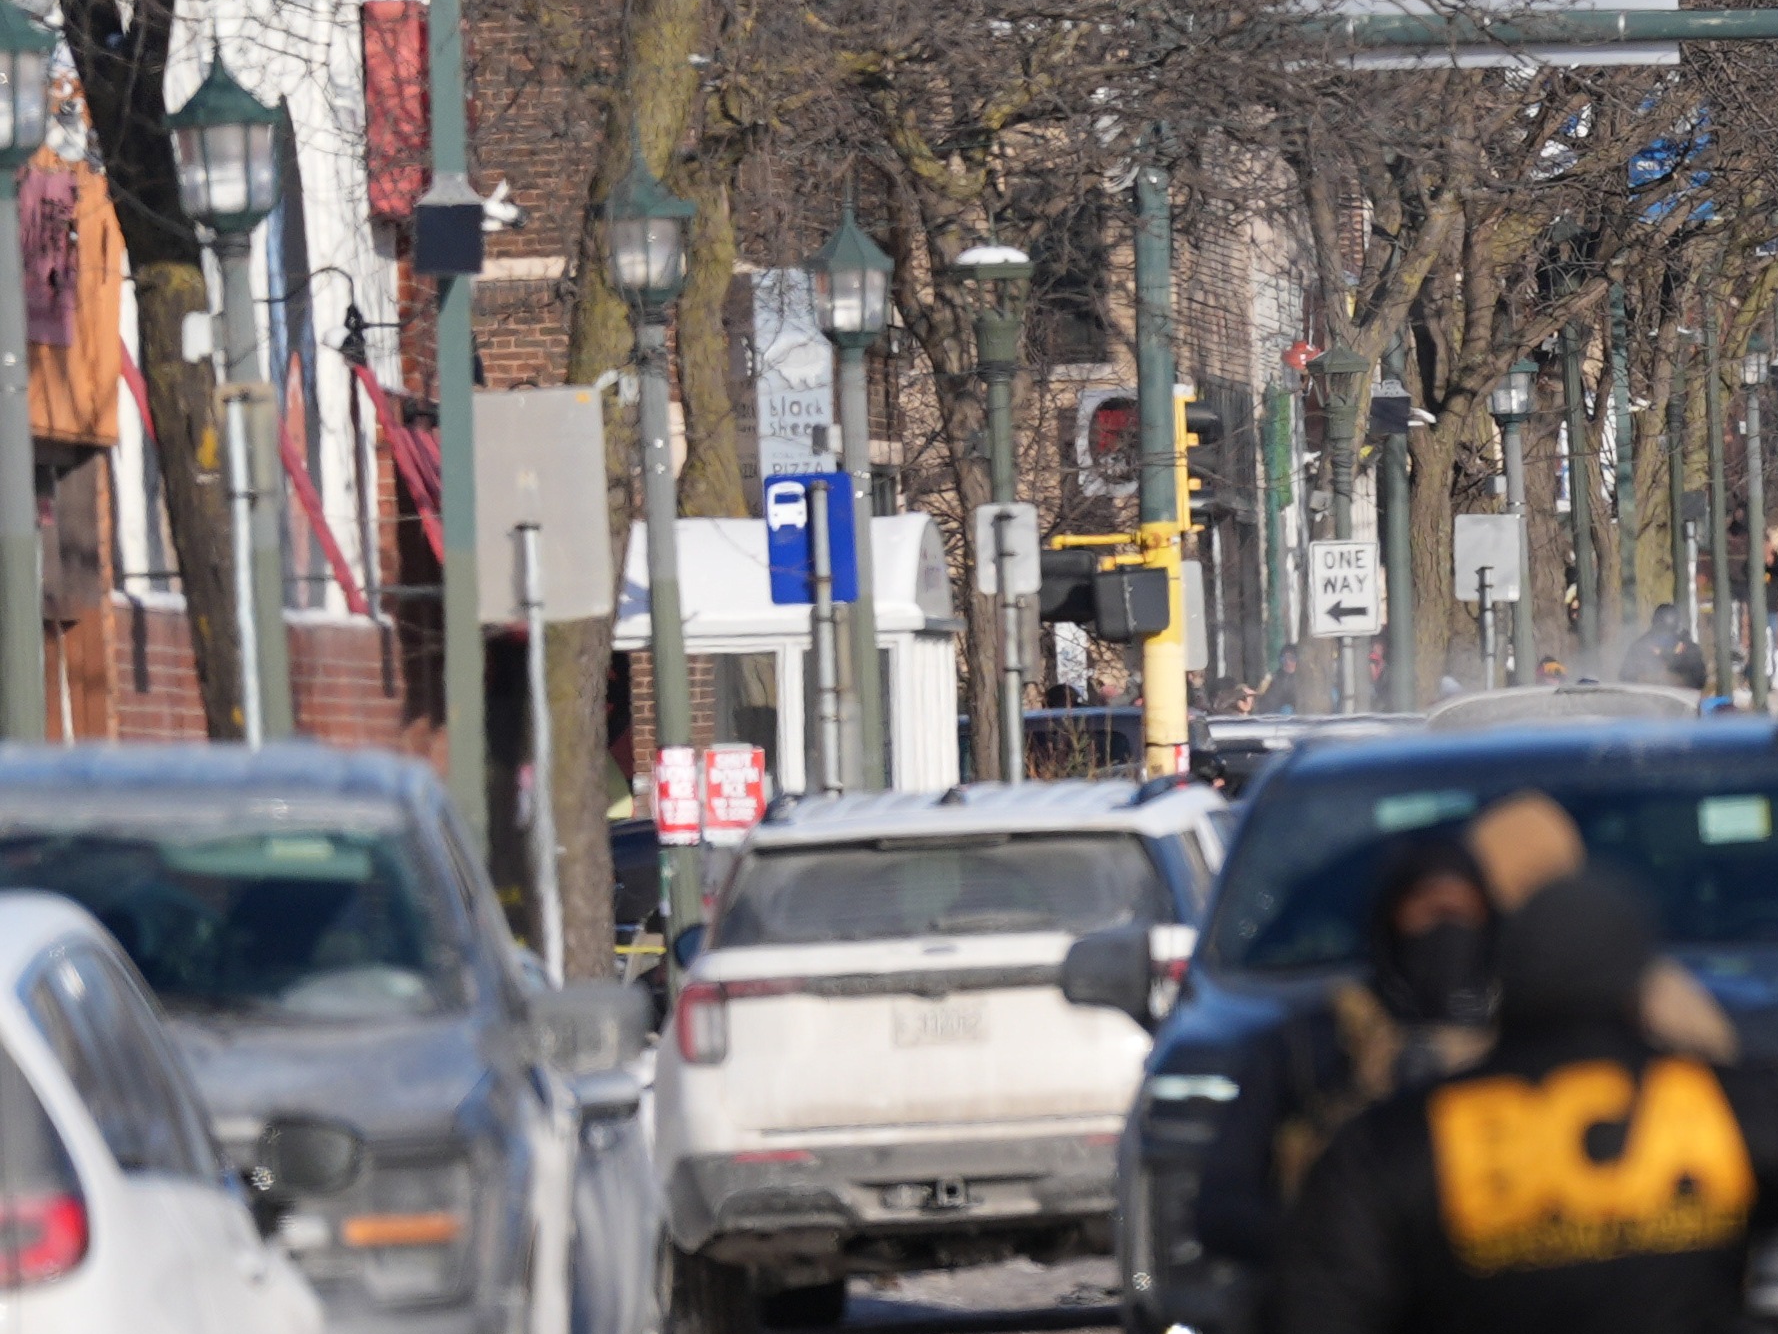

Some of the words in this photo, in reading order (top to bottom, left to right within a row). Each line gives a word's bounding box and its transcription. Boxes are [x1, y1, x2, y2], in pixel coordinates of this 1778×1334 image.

[768, 421, 814, 438] shee
[1323, 549, 1368, 570] ONE
[1323, 572, 1369, 595] WAY
